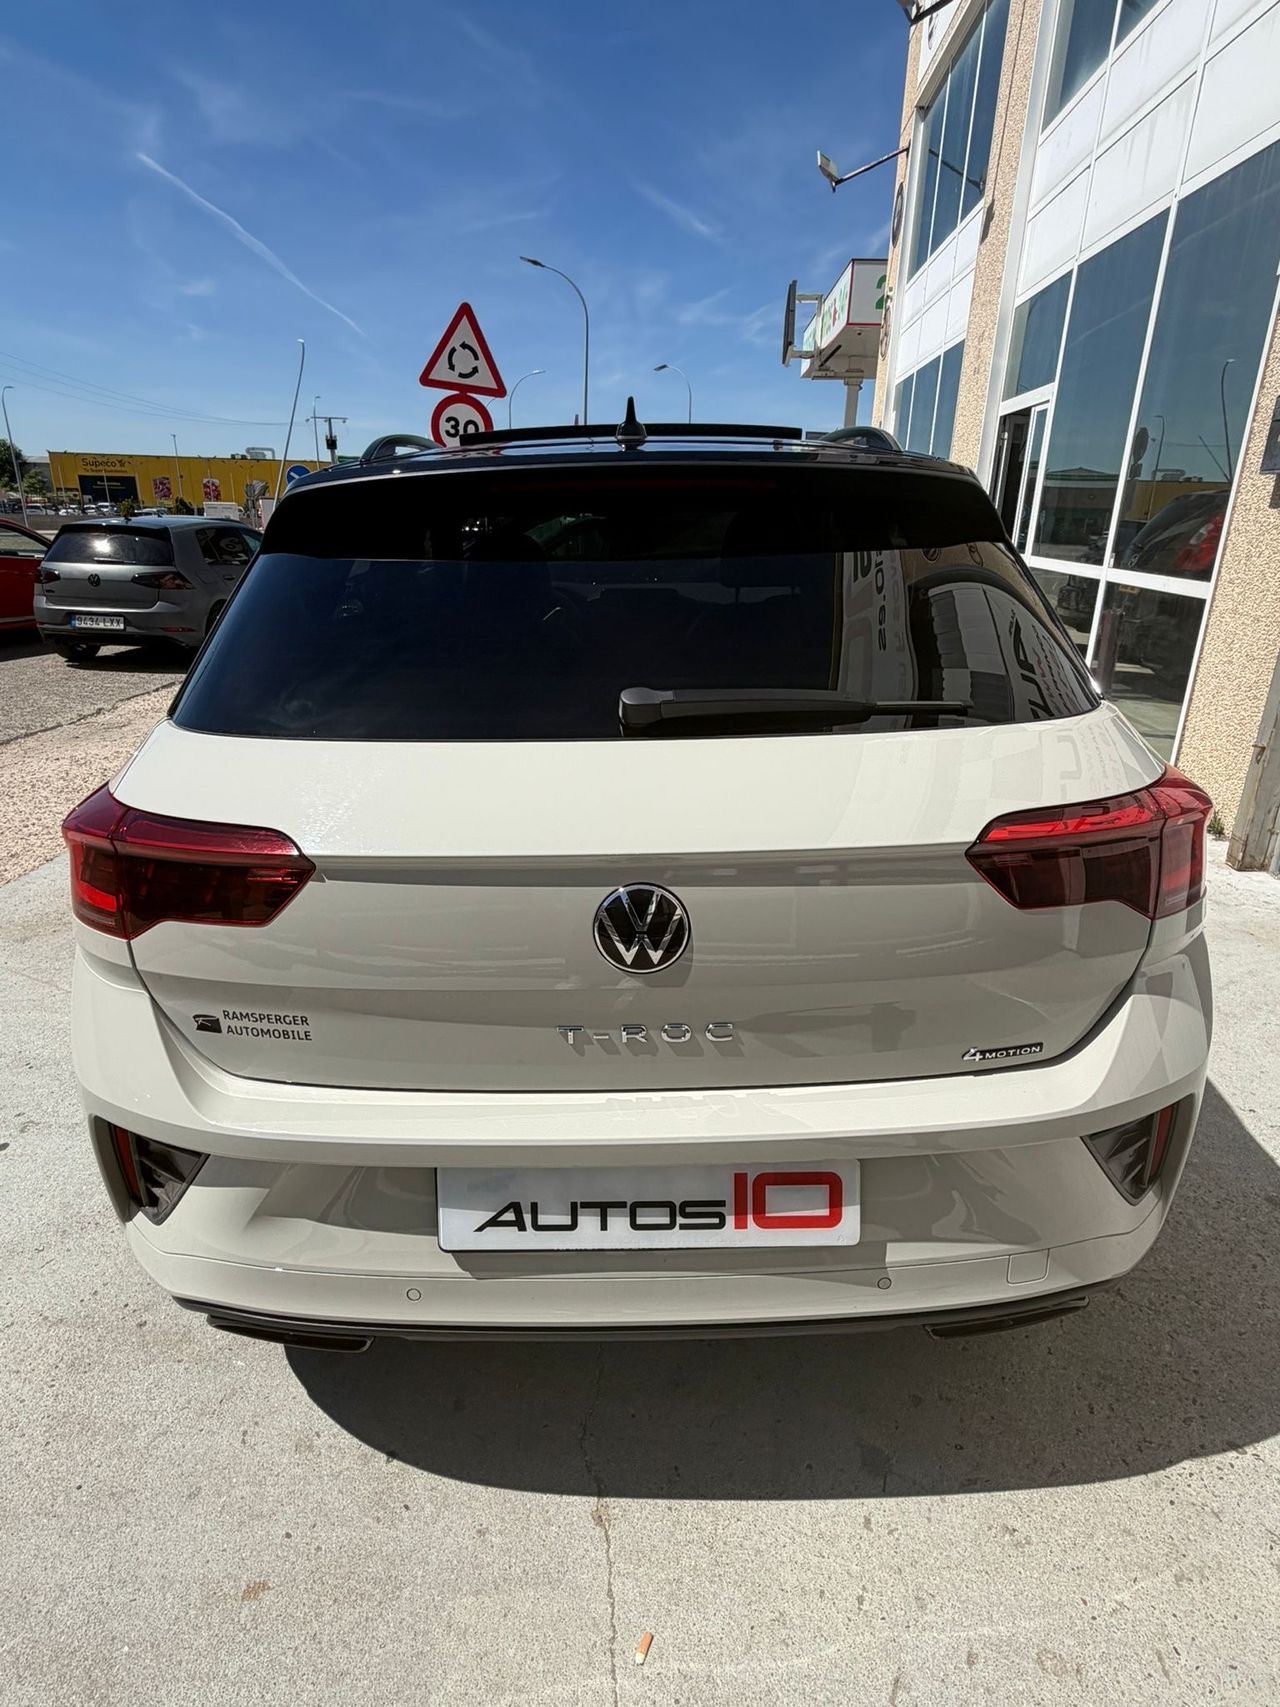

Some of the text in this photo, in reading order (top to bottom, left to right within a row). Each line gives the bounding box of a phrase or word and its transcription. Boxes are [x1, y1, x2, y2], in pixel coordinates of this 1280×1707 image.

[444, 416, 480, 438] 30
[81, 457, 117, 467] Supeco
[76, 616, 122, 629] 9434 LXX
[222, 1009, 310, 1026] RAMSPERGER
[226, 1025, 312, 1041] AUTOMOBILE
[556, 1022, 733, 1045] T-ROC
[962, 1046, 1041, 1061] 4MOTION
